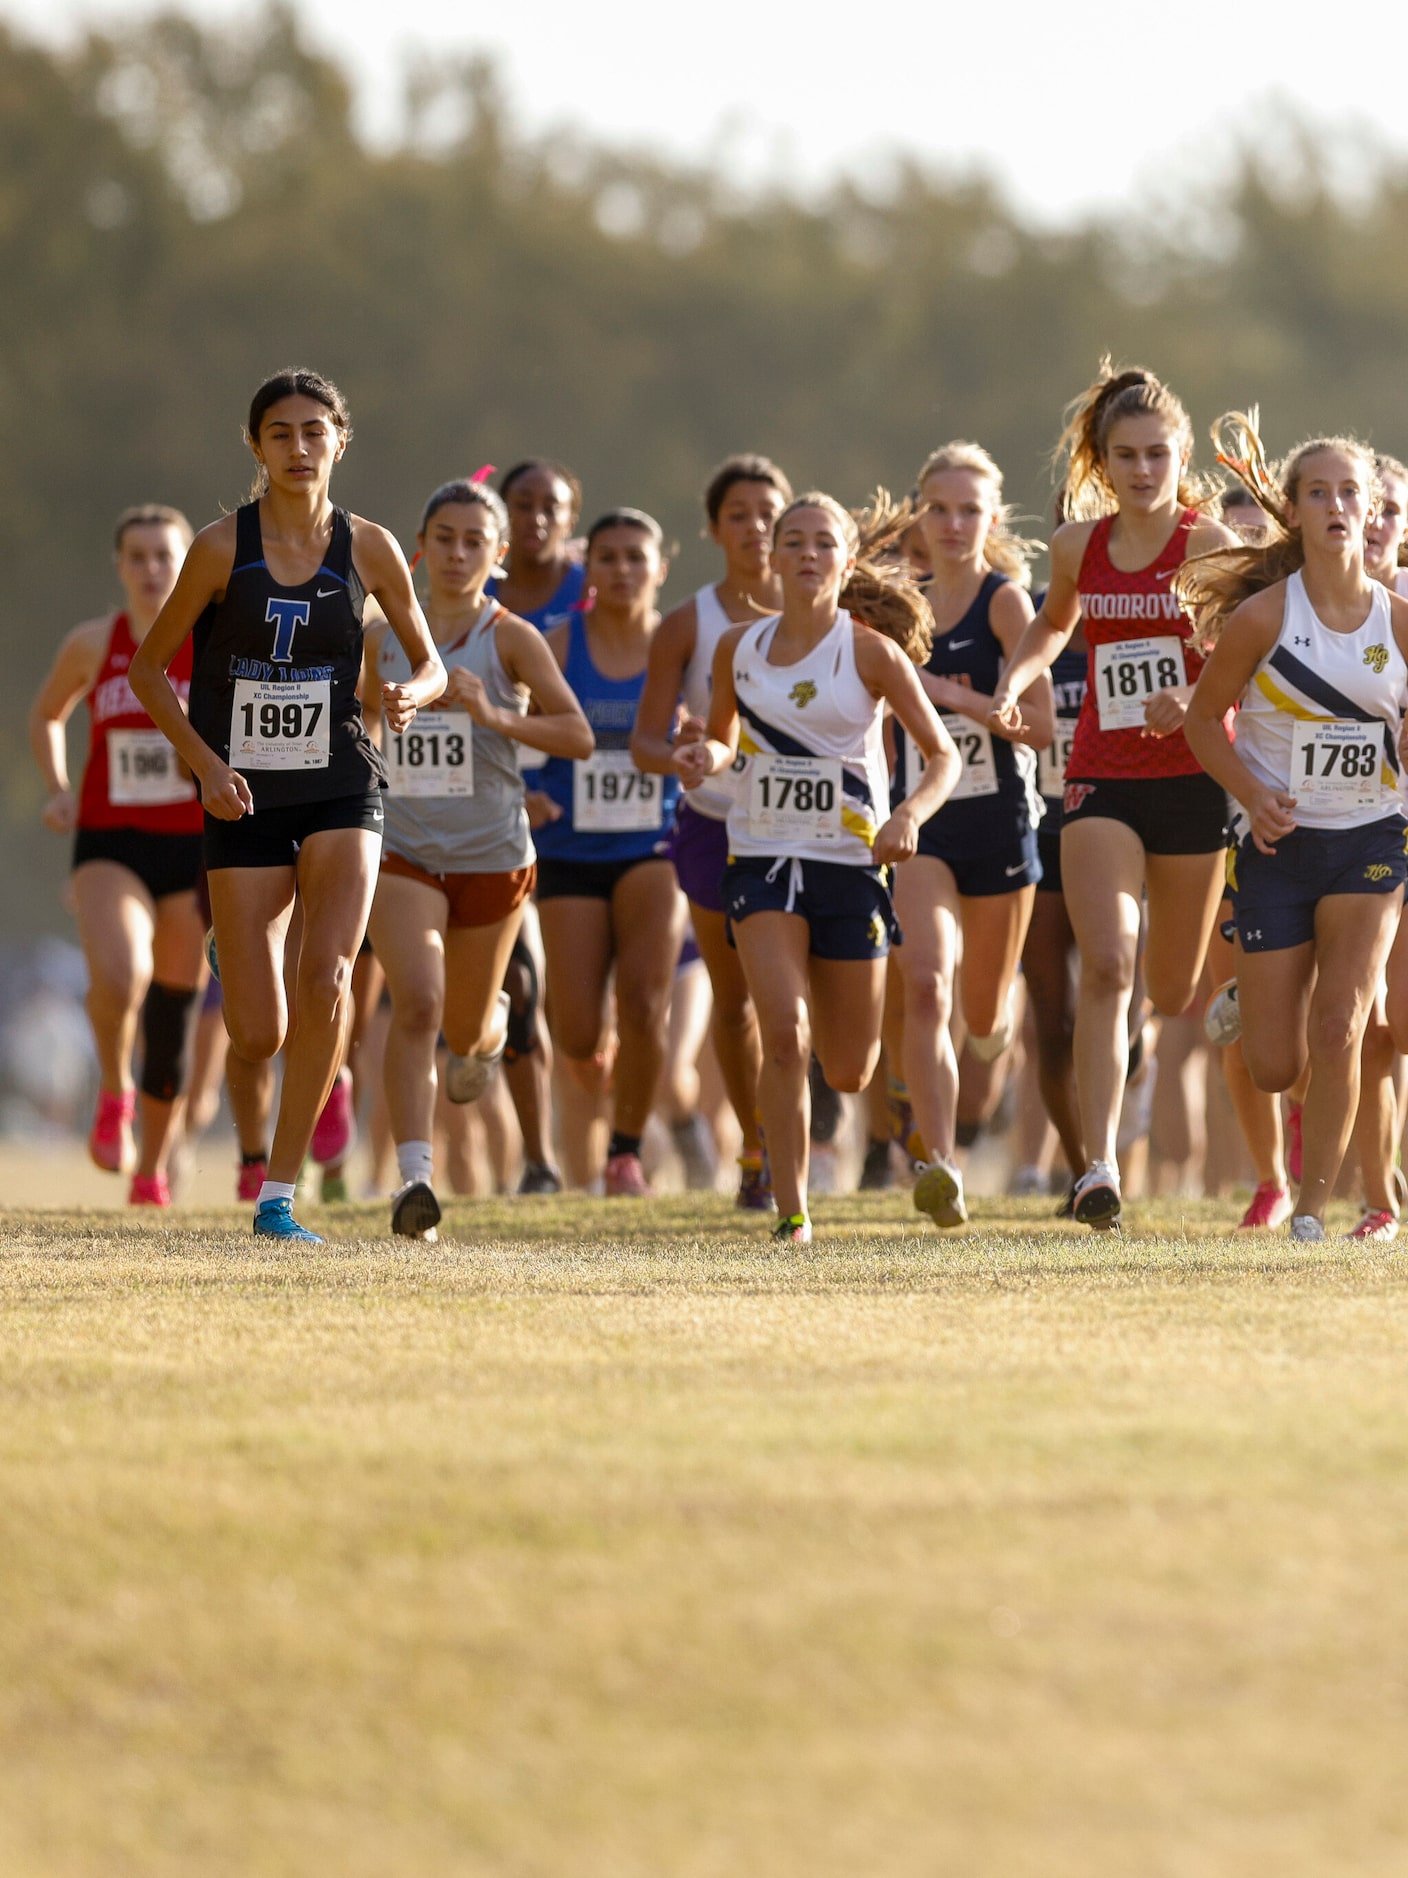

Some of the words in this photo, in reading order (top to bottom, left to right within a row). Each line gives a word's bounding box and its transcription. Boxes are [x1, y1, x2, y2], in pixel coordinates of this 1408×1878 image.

[265, 597, 310, 662] T
[229, 654, 274, 681] LADY
[279, 666, 335, 681] LIONS
[1102, 657, 1179, 698] 1818
[263, 693, 310, 701] Championship
[272, 684, 294, 692] Region
[241, 702, 323, 738] 1997
[1334, 724, 1355, 732] Region
[394, 734, 465, 767] 1813
[1325, 733, 1367, 741] Championship
[1301, 743, 1377, 778] 1783
[585, 772, 655, 802] 1975
[758, 776, 834, 812] 1780
